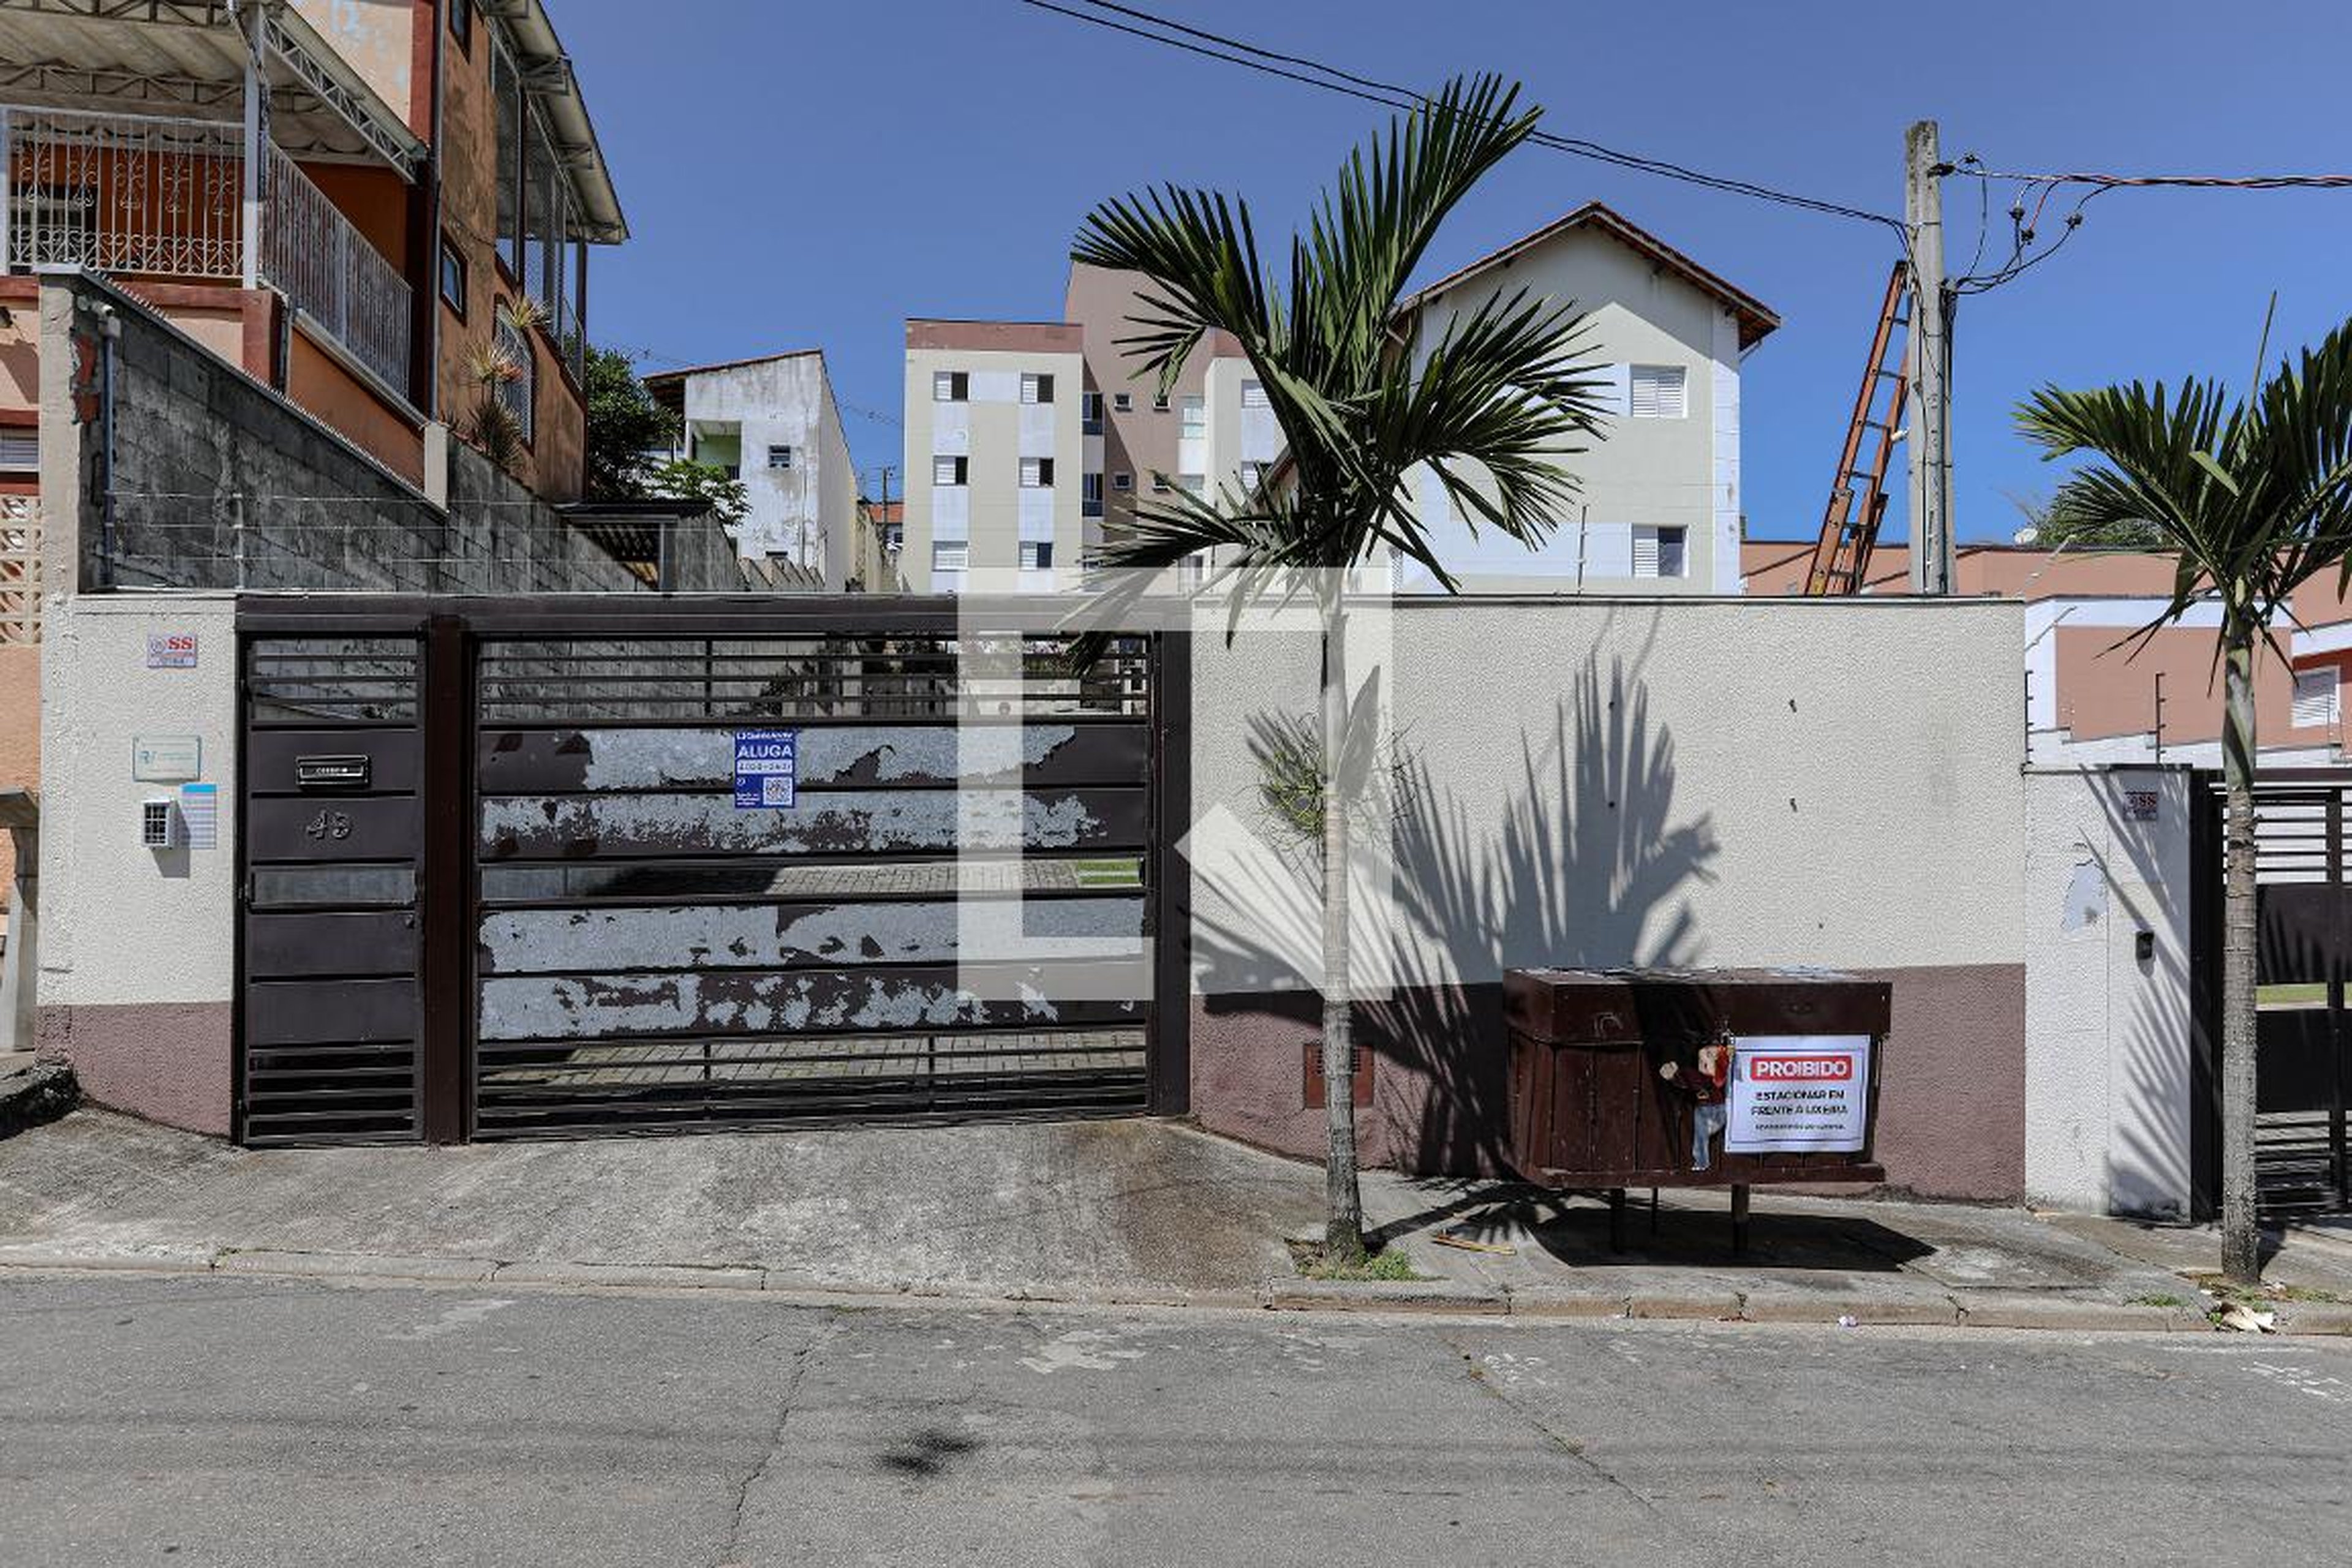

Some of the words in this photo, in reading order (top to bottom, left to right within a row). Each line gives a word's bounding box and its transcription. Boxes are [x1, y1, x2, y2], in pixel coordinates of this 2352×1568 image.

[736, 745, 793, 758] ALUGA
[1756, 1060, 1848, 1077] PROIBIDO
[1756, 1090, 1827, 1101] ESTACIONAR
[1751, 1105, 1793, 1115] FRENTE
